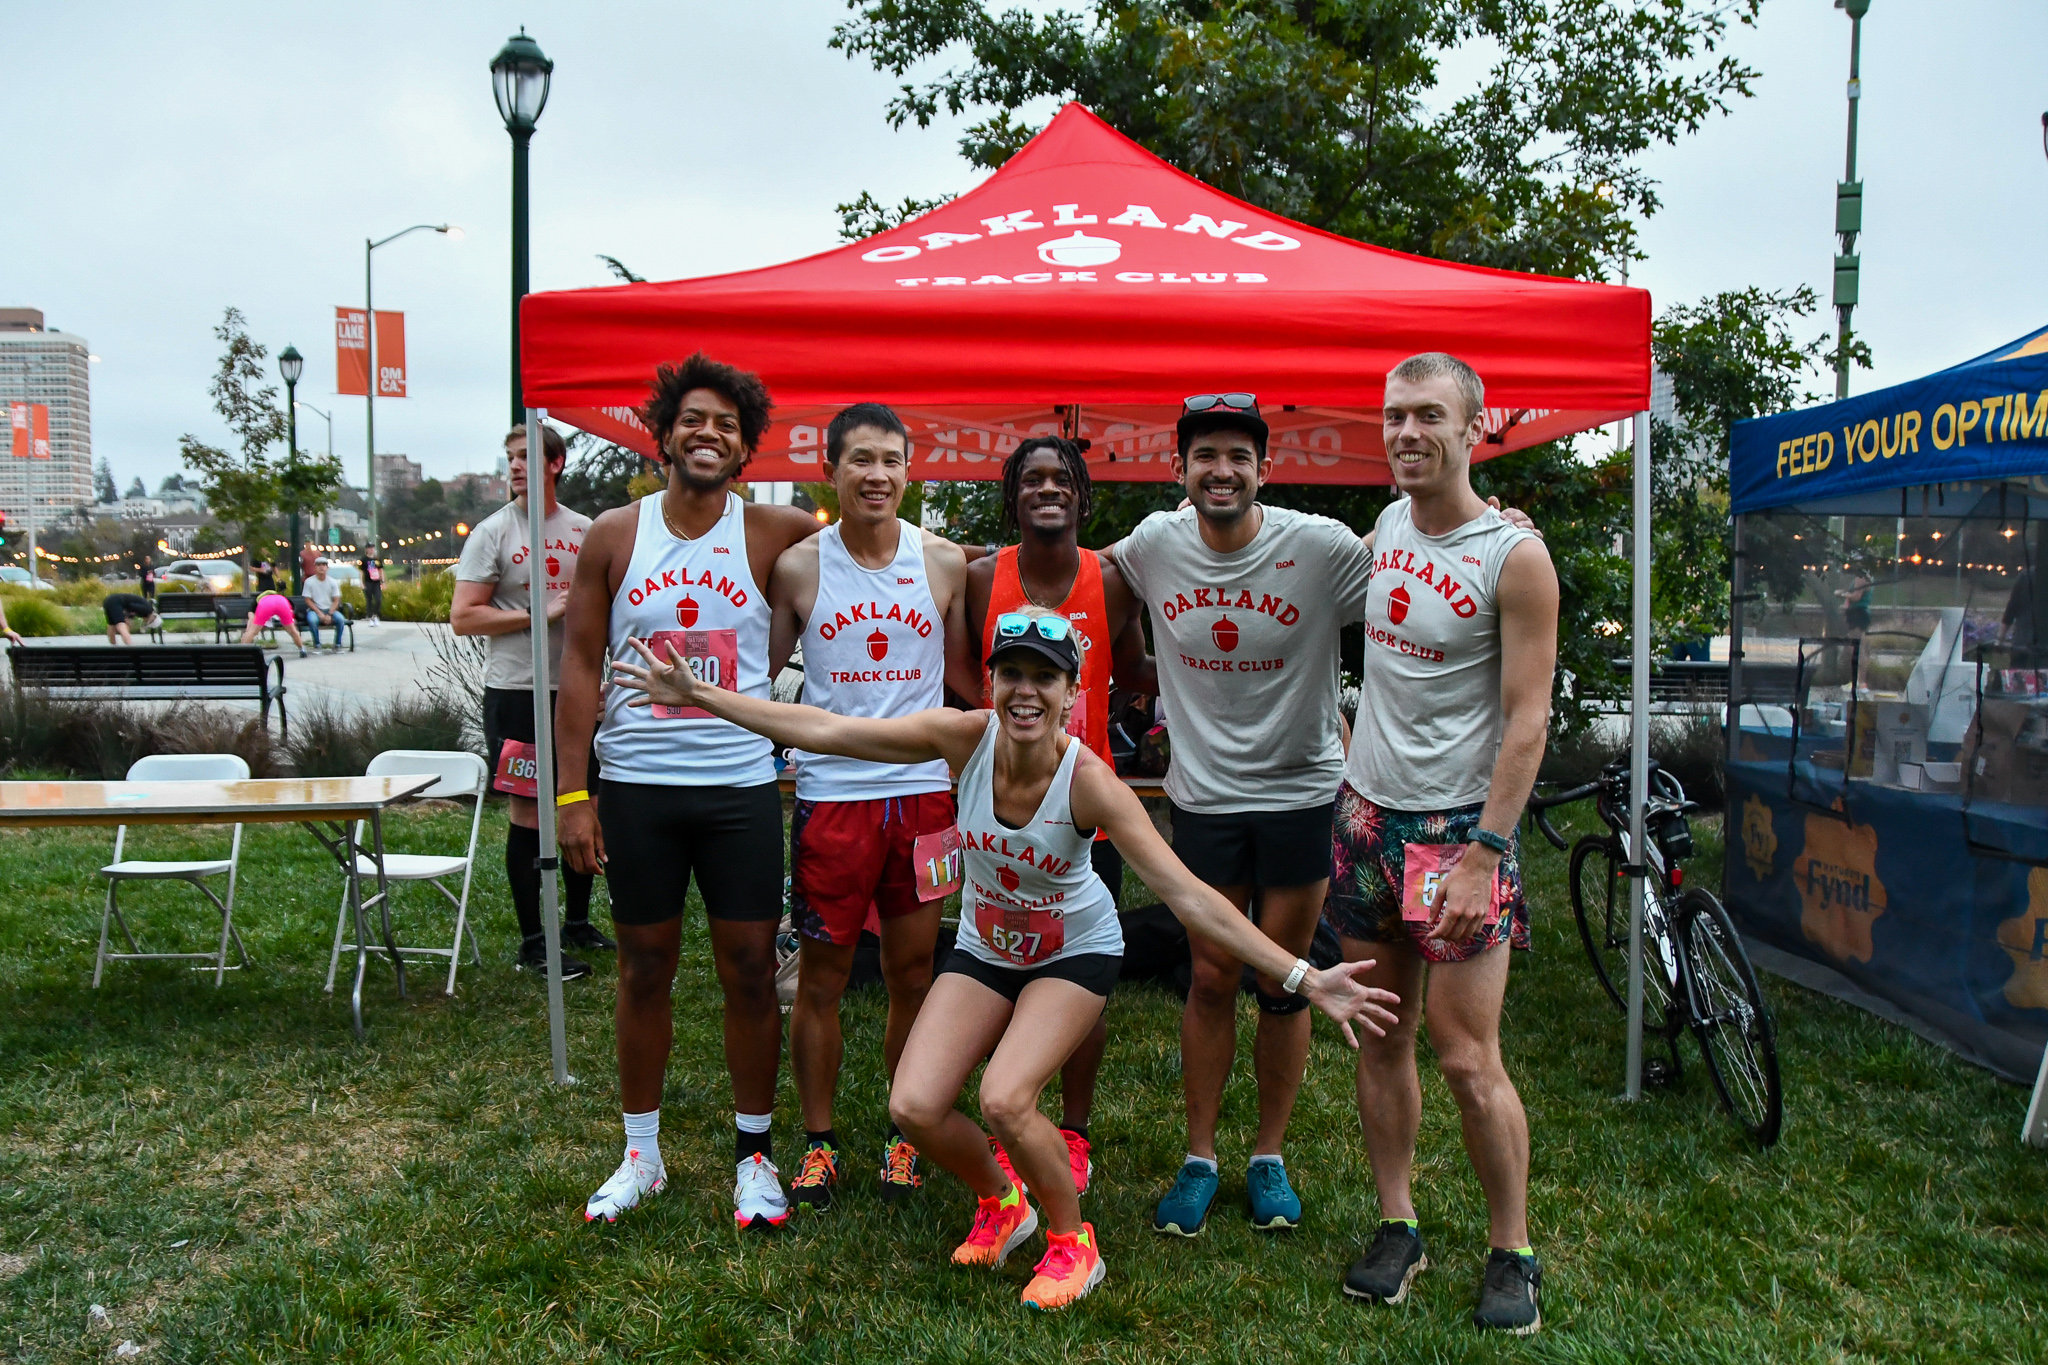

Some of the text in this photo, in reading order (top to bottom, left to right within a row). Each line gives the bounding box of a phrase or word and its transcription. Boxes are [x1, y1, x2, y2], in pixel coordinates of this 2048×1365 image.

[861, 203, 1301, 263] OAKLAND
[895, 270, 1269, 287] TRACK CLUB
[338, 322, 364, 340] LAKE
[380, 367, 402, 379] OM
[1776, 389, 2048, 478] FEED YOUR OPTIM
[512, 538, 580, 565] OALAN
[628, 567, 748, 608] OAKLAND
[819, 601, 932, 641] OAKLAND
[1163, 588, 1300, 626] OAKLAND
[1179, 653, 1285, 673] TRACK CLUB
[1400, 640, 1445, 663] CLUB
[684, 655, 720, 687] 30
[830, 668, 922, 684] TRACK CLUB
[507, 757, 538, 779] 136
[926, 847, 960, 887] 117
[970, 876, 1066, 910] TRACK CLUB
[1806, 859, 1870, 912] Fynd
[992, 923, 1042, 957] 527
